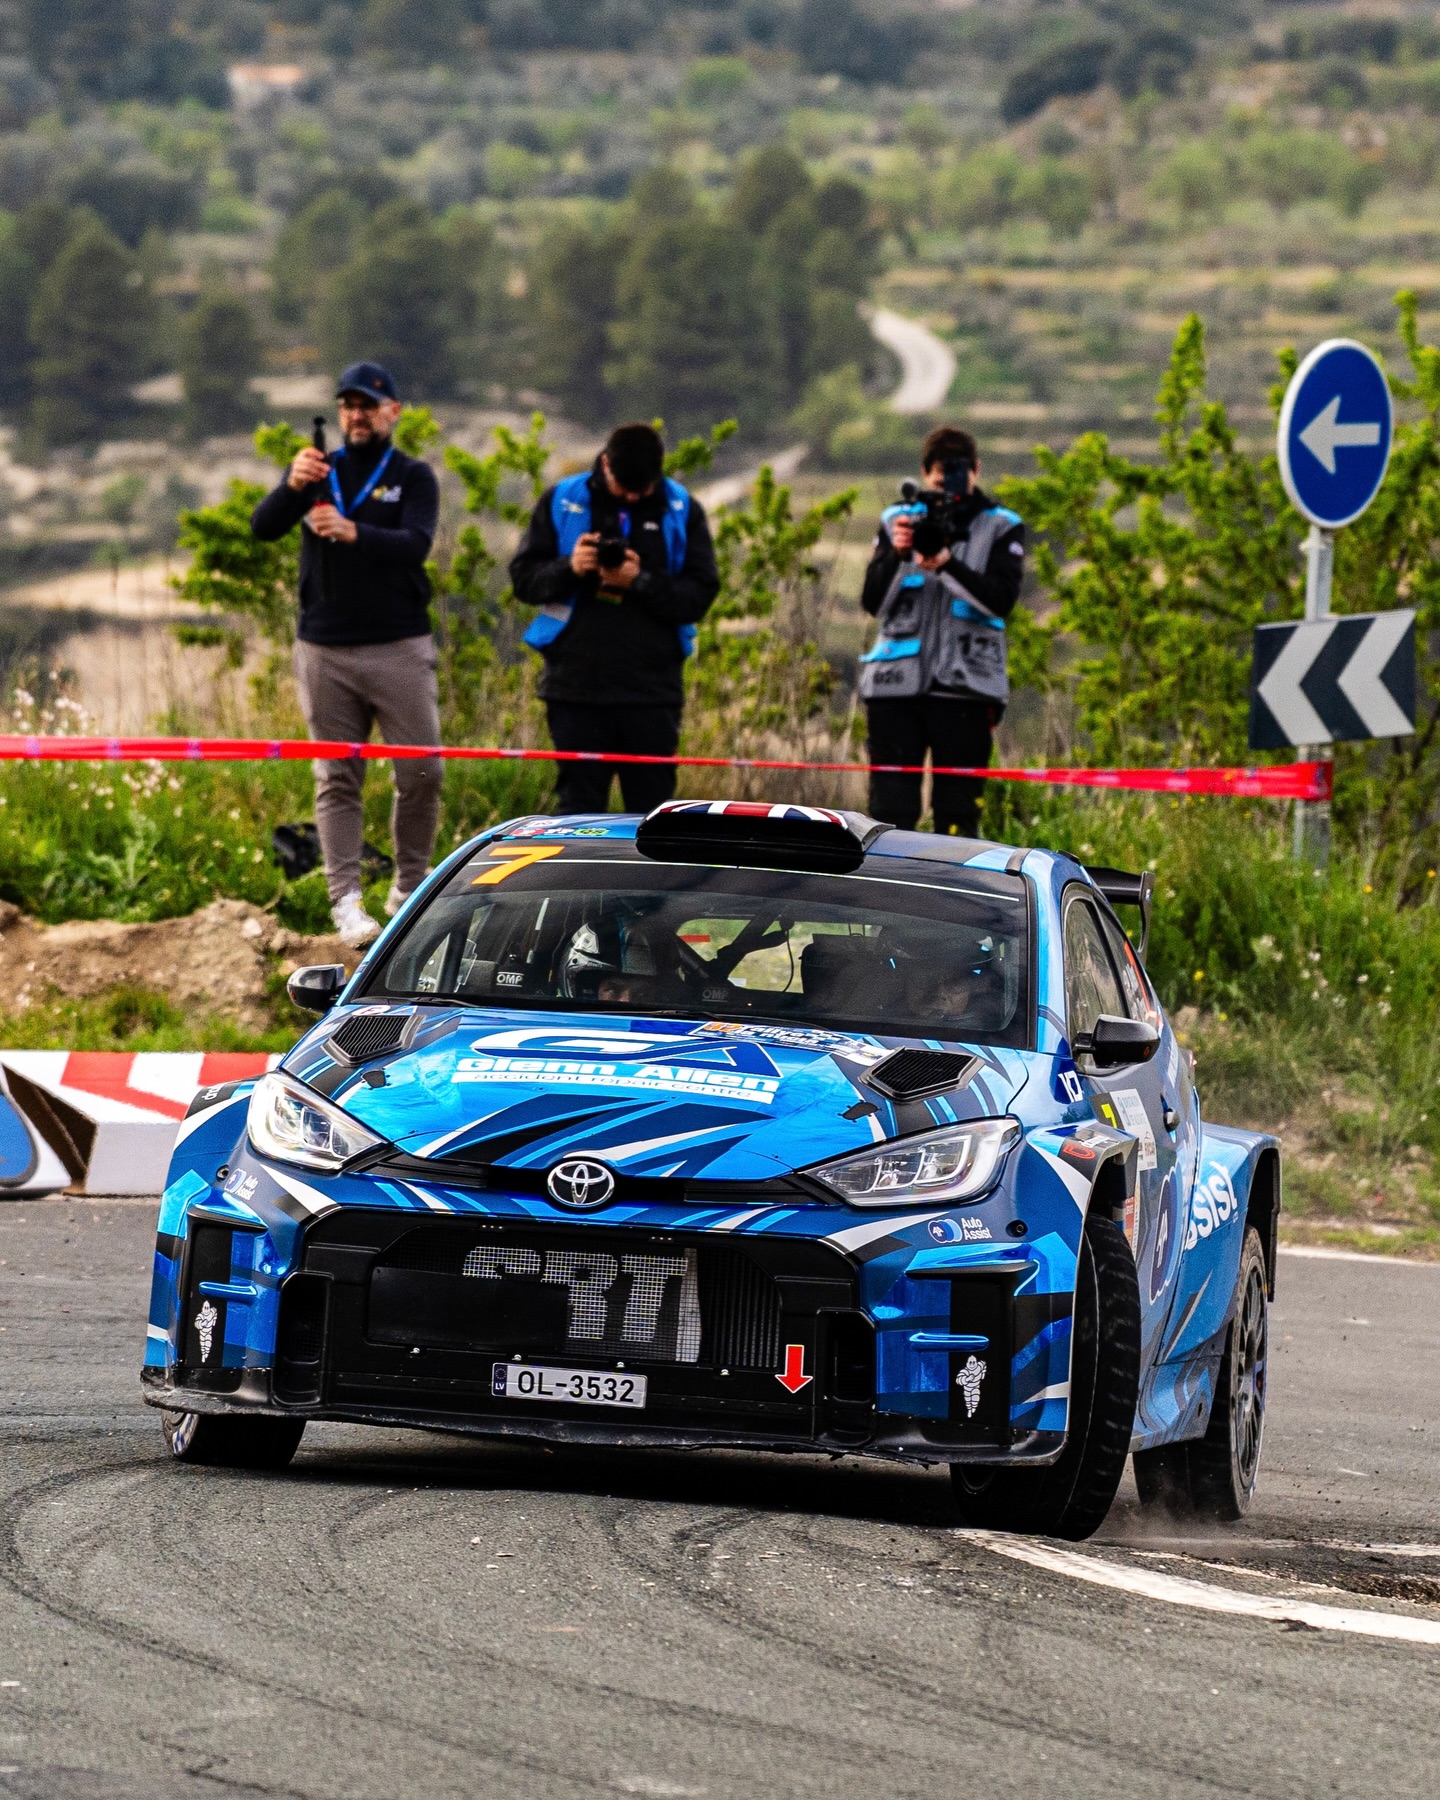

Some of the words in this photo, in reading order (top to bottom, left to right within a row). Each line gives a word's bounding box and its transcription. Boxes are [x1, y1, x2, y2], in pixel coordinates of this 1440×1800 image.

[472, 845, 566, 885] 7
[496, 974, 522, 984] OMP
[457, 1058, 618, 1074] Glenn
[632, 1065, 780, 1092] Allen
[473, 1073, 581, 1083] accident
[591, 1076, 661, 1088] repair
[671, 1083, 752, 1099] centre
[961, 1217, 983, 1229] Auto
[963, 1227, 992, 1240] Assist
[495, 1382, 505, 1390] LV
[517, 1370, 635, 1403] OL-3532
